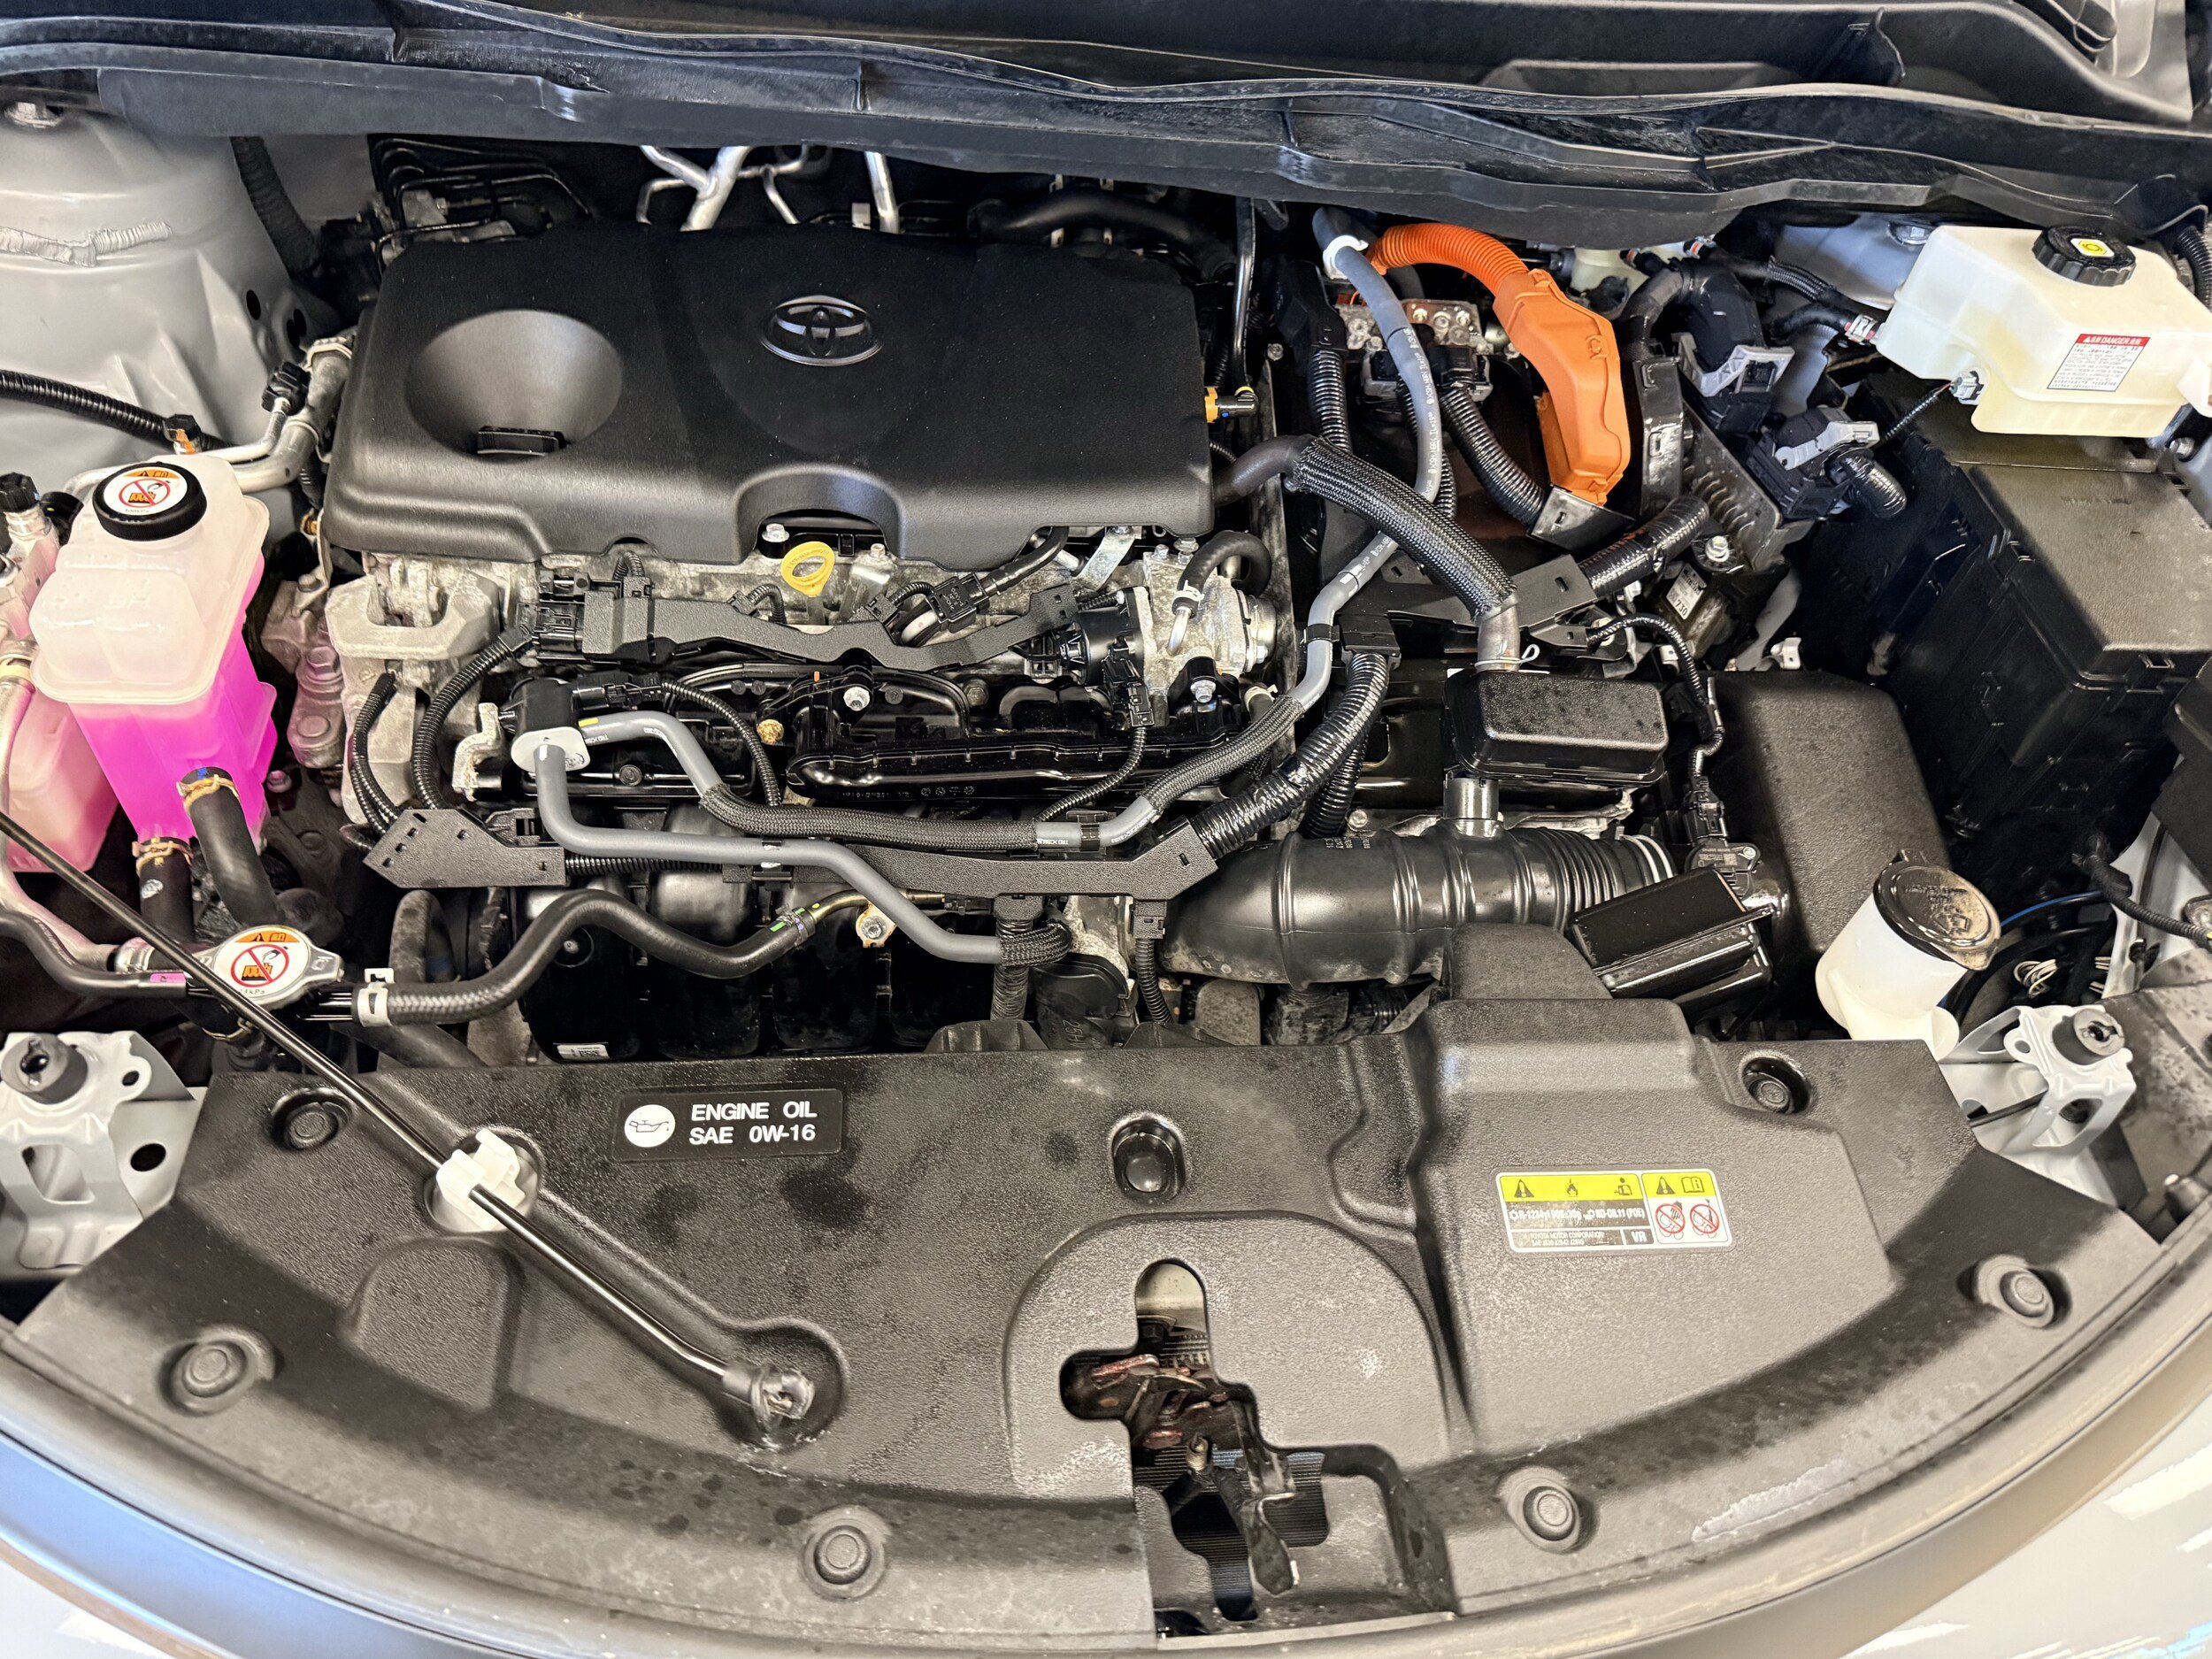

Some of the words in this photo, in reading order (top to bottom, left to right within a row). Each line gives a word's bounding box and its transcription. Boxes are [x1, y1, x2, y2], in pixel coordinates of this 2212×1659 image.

[2101, 336, 2130, 345] DANGER
[1675, 599, 1688, 616] 730
[691, 1102, 770, 1121] ENGINE
[782, 1101, 818, 1118] OIL
[688, 1126, 733, 1145] SAE
[749, 1124, 816, 1143] 0W-16
[1626, 1208, 1646, 1219] (POE)
[1631, 1232, 1647, 1243] VR
